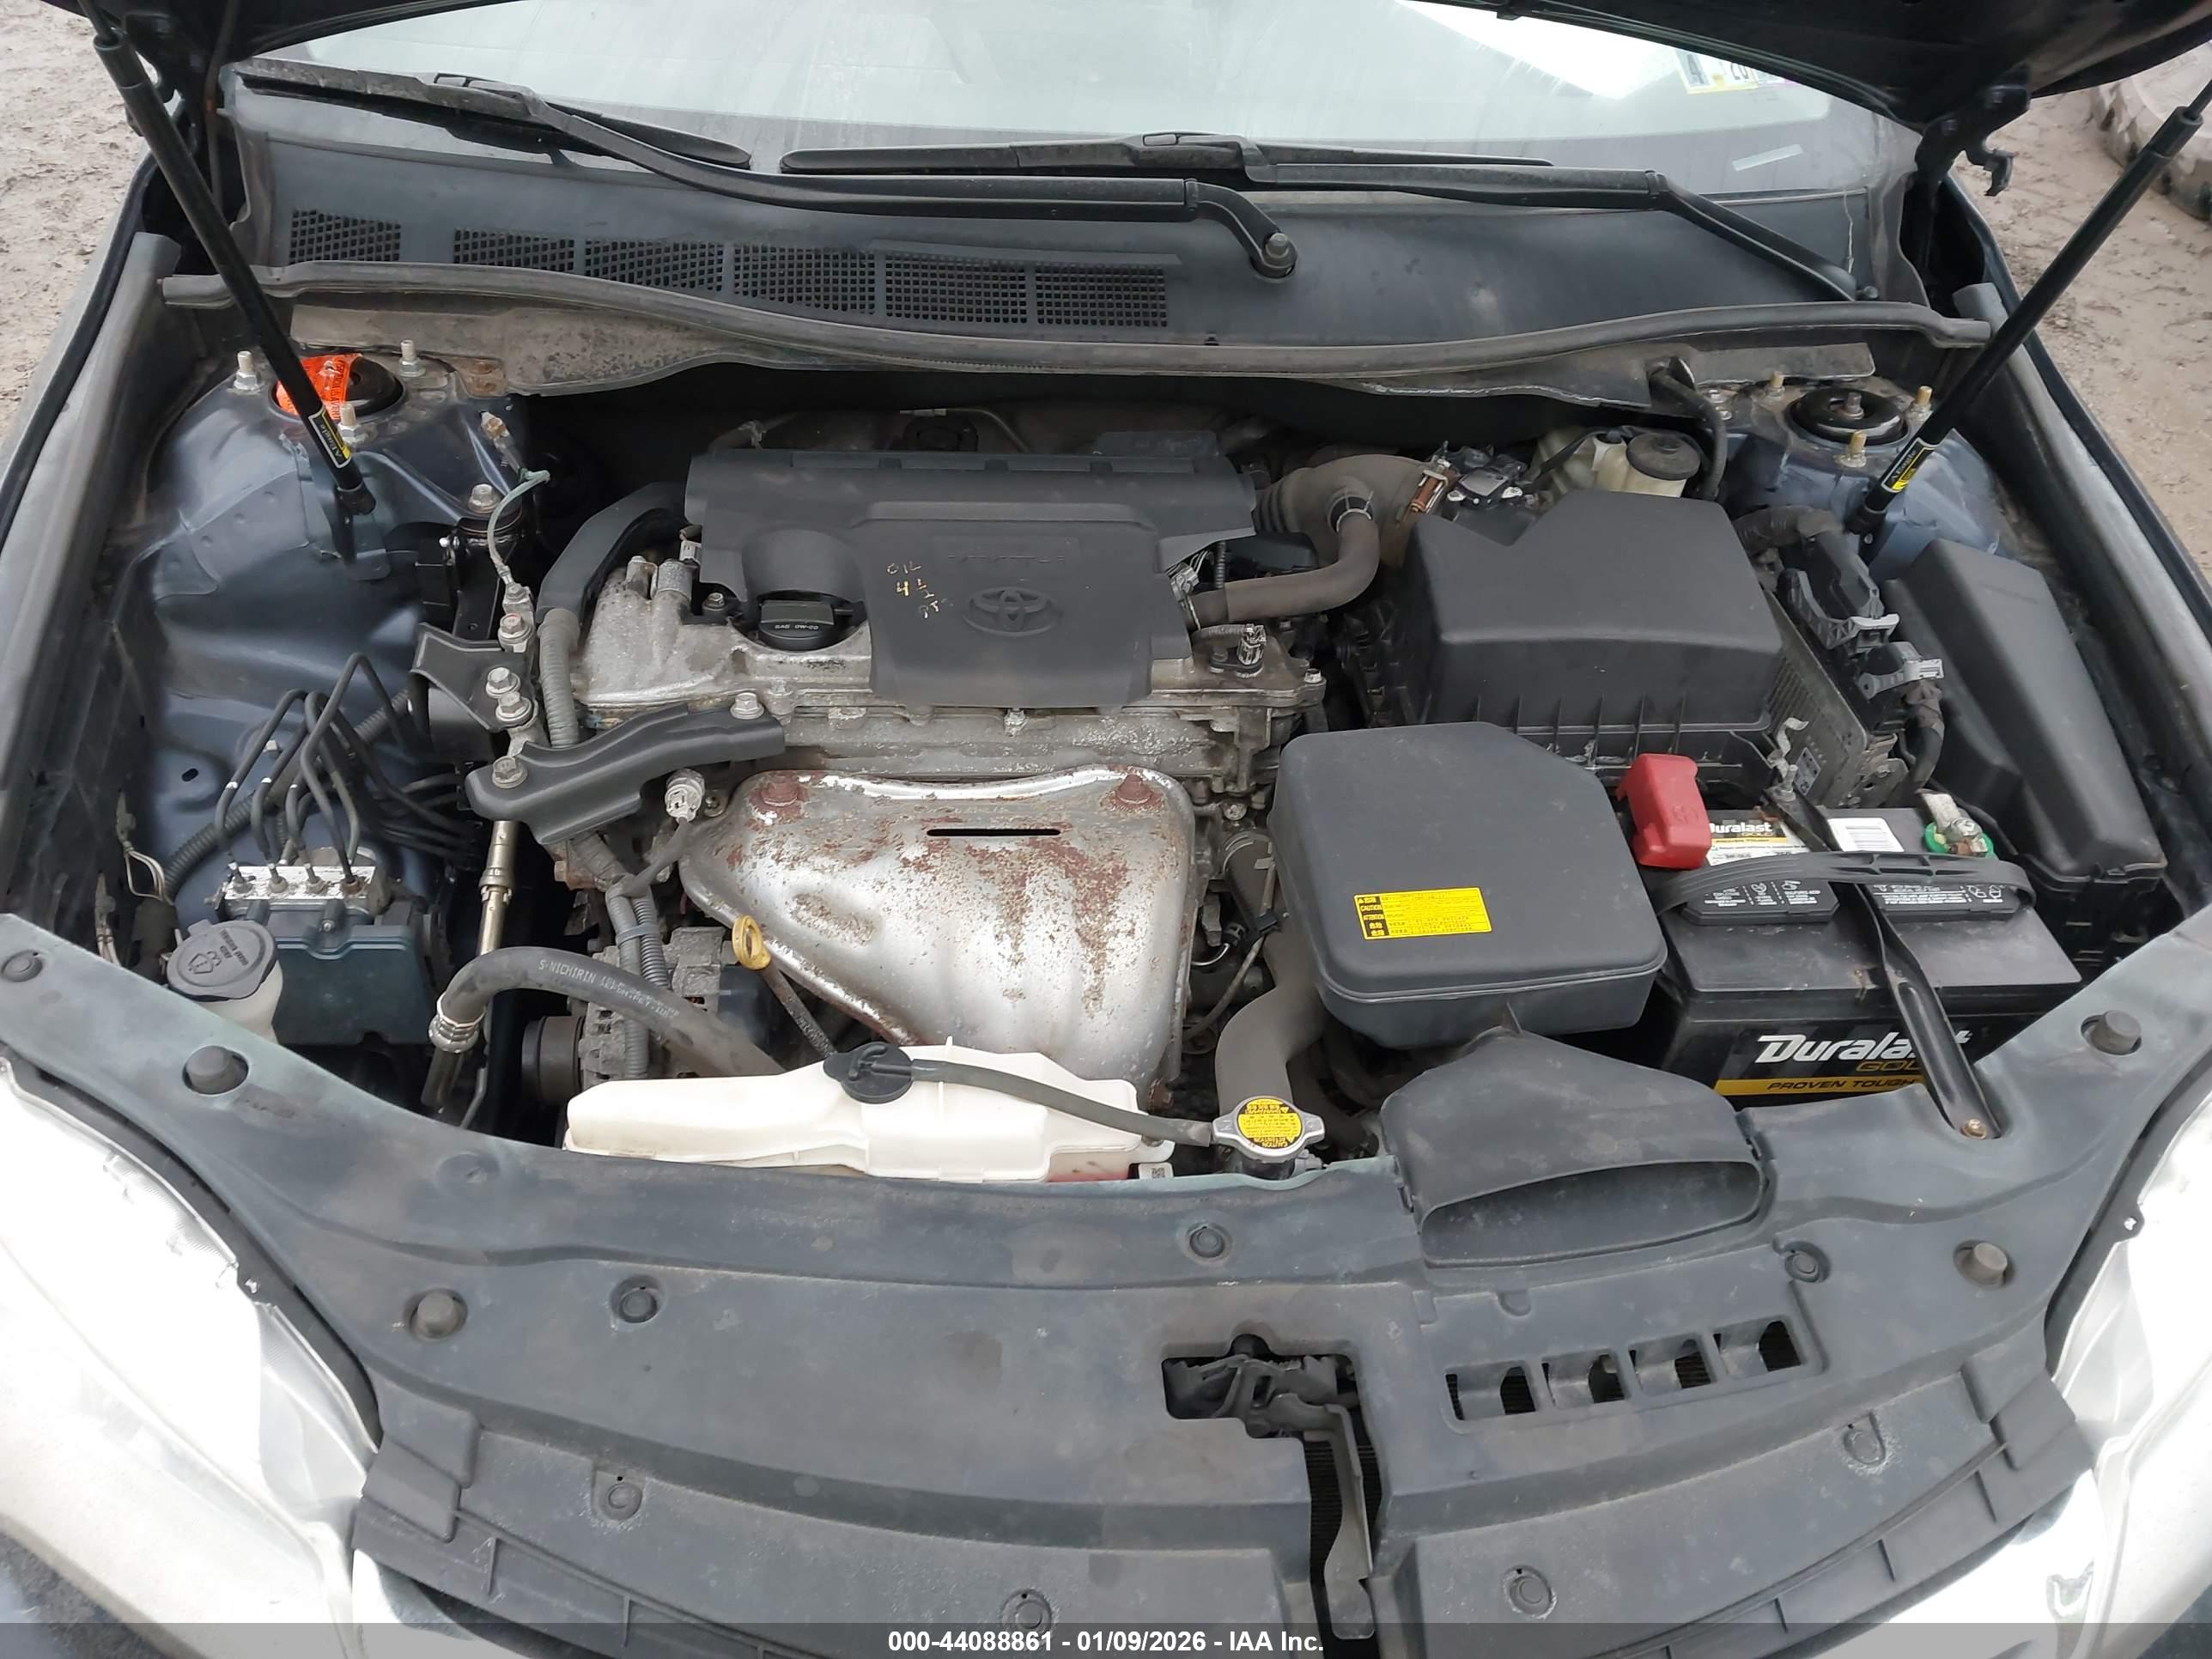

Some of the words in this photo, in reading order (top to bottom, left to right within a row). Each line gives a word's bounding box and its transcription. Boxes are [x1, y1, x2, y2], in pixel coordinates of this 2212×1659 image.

[886, 561, 921, 574] OIL
[1754, 1030, 1973, 1063] Duralat
[1856, 1060, 1922, 1073] GOL
[1766, 1080, 1846, 1091] PROVEN
